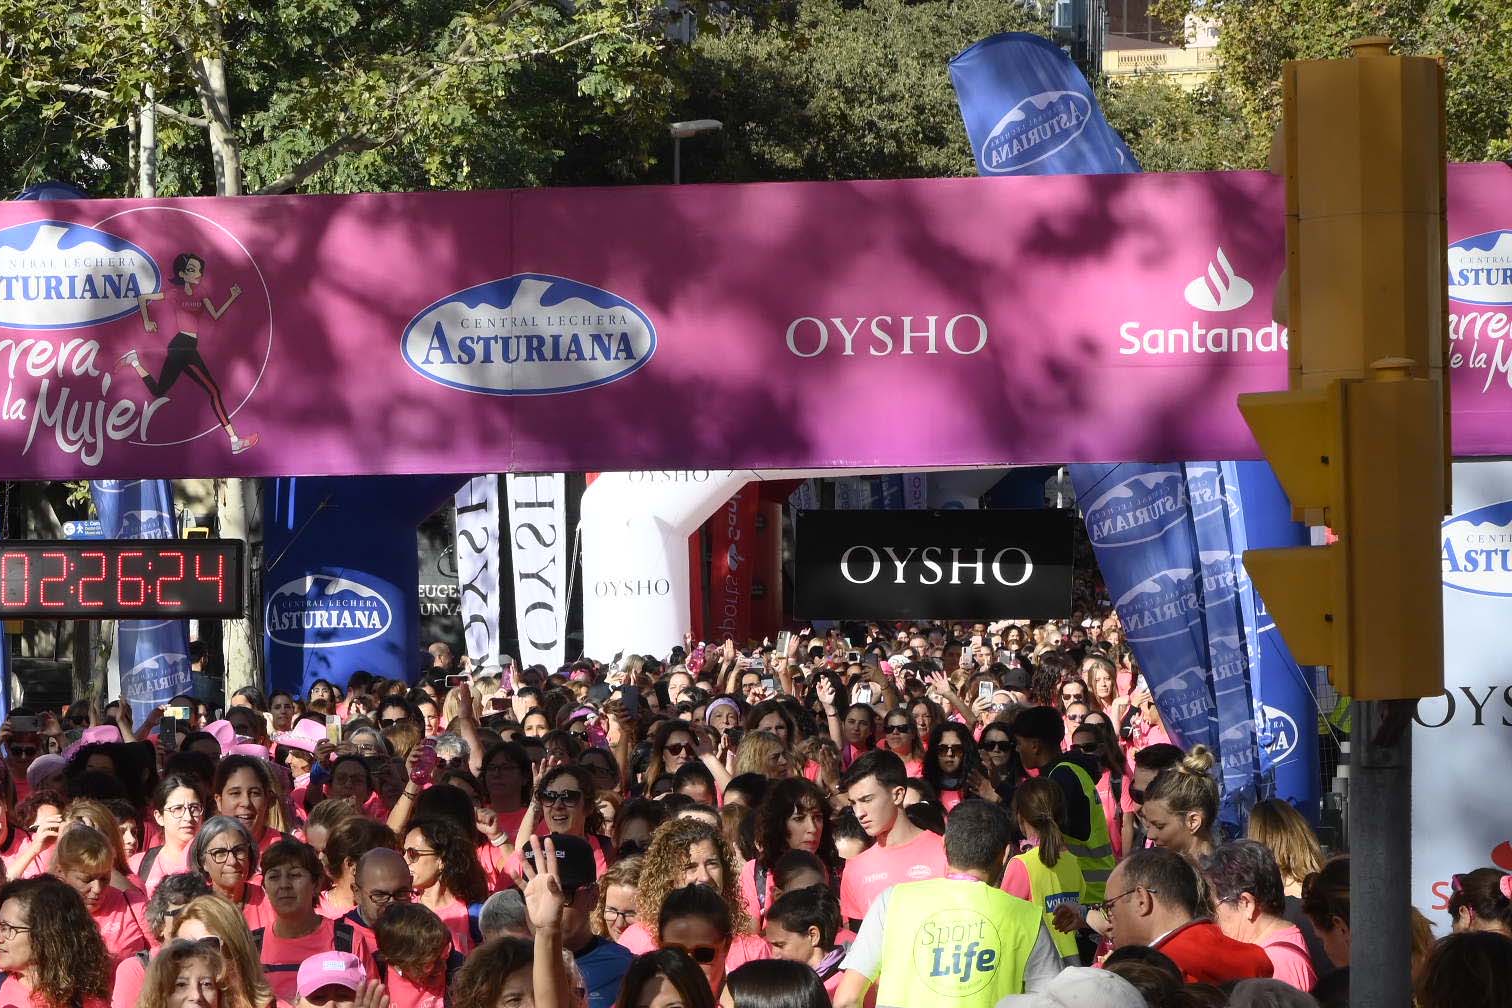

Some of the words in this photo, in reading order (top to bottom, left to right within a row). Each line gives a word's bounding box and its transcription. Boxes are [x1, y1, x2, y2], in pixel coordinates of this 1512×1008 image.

[64, 257, 137, 269] LECHERA
[460, 316, 539, 329] CENTRAL
[547, 314, 628, 327] LECHERA
[786, 313, 988, 358] OYSHO
[420, 320, 638, 366] ASTURIANA
[1470, 341, 1487, 369] la
[2, 381, 26, 421] la
[22, 371, 171, 466] Mujer
[0, 552, 225, 607] 02:26:24
[840, 545, 1034, 586] OYSHO
[594, 578, 671, 598] OYSHO
[268, 605, 382, 632] ASTURIANA
[921, 918, 986, 948] Sport
[930, 941, 996, 983] Life
